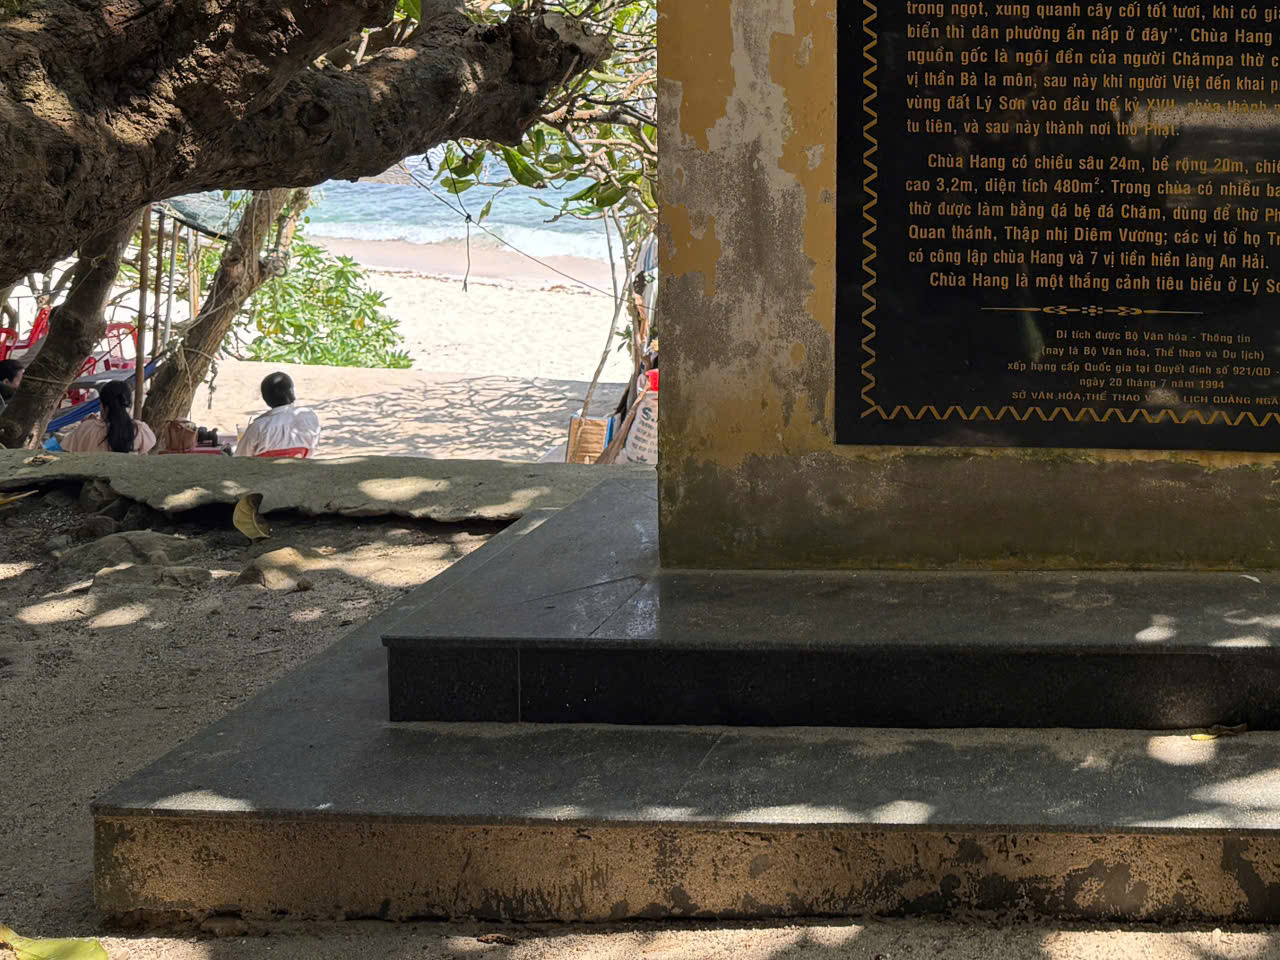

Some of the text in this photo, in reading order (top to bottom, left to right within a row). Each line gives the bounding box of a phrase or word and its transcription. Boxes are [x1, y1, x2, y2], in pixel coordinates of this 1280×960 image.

[905, 0, 944, 18] trong
[951, 1, 988, 18] ngọt,
[995, 4, 1030, 19] xung
[1036, 2, 1080, 19] quanh
[1087, 3, 1112, 20] cây
[1118, 1, 1140, 18] cối
[1146, 1, 1167, 18] tốt
[1172, 4, 1205, 21] tươi,
[1212, 4, 1234, 20] khi
[1240, 5, 1257, 20] có
[906, 21, 939, 39] biển
[945, 24, 964, 40] thì
[971, 24, 999, 40] dân
[1005, 25, 1060, 43] phường
[1066, 23, 1085, 41] ẩn
[1091, 24, 1119, 44] nấp
[1125, 25, 1135, 41] ở
[1190, 27, 1228, 43] Chùa
[1234, 29, 1272, 47] Hang
[906, 46, 954, 65] nguồn
[960, 46, 988, 66] gốc
[994, 48, 1008, 63] là
[1055, 48, 1083, 65] đền
[1089, 48, 1117, 65] của
[1122, 50, 1165, 68] người
[1172, 51, 1234, 69] Chămpa
[1240, 52, 1264, 67] thờ
[906, 71, 918, 88] vị
[924, 69, 954, 87] thần
[959, 71, 977, 87] Bà
[983, 72, 996, 88] la
[1002, 72, 1037, 89] môn,
[1043, 75, 1067, 88] sau
[1072, 73, 1098, 91] này
[1102, 73, 1123, 89] khi
[1128, 74, 1167, 92] người
[1172, 74, 1200, 92] Việt
[1205, 73, 1230, 90] đến
[1236, 76, 1264, 91] khai
[908, 201, 932, 216] thờ
[937, 201, 971, 218] được
[977, 201, 1004, 217] làm
[1010, 200, 1044, 220] bằng
[1050, 202, 1067, 219] đá
[1074, 203, 1090, 221] bệ
[1097, 203, 1114, 219] đá
[1120, 204, 1165, 222] Chăm,
[1172, 205, 1207, 224] dùng
[1213, 203, 1229, 221] để
[1236, 207, 1259, 223] thờ
[908, 224, 945, 240] Quan
[951, 225, 997, 241] thánh,
[1004, 225, 1040, 244] Thập
[1045, 226, 1067, 244] nhị
[1073, 227, 1112, 242] Diêm
[1118, 228, 1168, 246] Vương;
[1173, 229, 1200, 244] các
[1204, 230, 1216, 247] vị
[1223, 227, 1237, 245] tổ
[1243, 231, 1260, 248] họ
[929, 271, 969, 288] Chùa
[972, 272, 1009, 291] Hang
[1015, 271, 1029, 289] là
[1035, 273, 1064, 291] một
[1068, 271, 1109, 292] thắng
[1115, 273, 1150, 290] cảnh
[1155, 276, 1184, 291] tiêu
[1190, 274, 1221, 292] biểu
[1227, 276, 1237, 293] ở
[1242, 278, 1259, 296] Lý
[1109, 376, 1122, 387] 20
[1199, 380, 1224, 389] 1994
